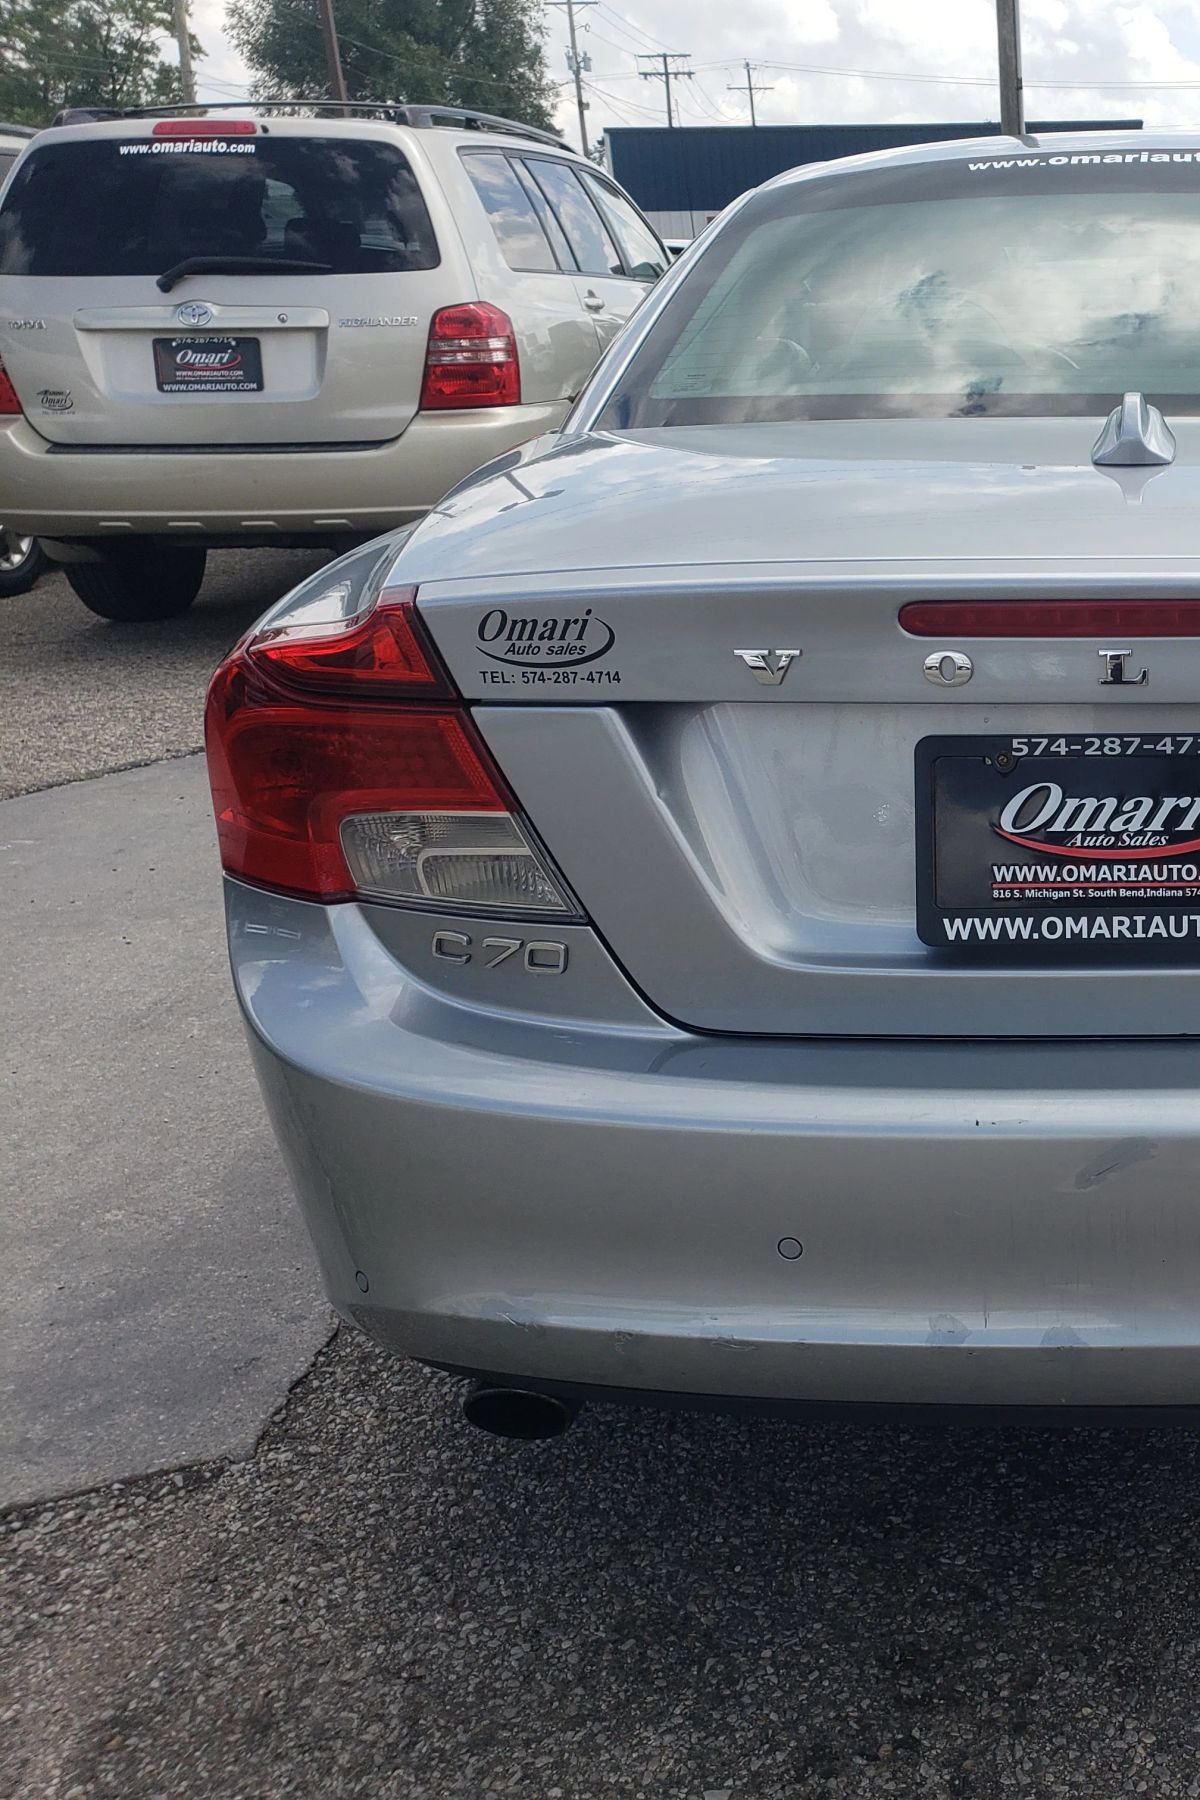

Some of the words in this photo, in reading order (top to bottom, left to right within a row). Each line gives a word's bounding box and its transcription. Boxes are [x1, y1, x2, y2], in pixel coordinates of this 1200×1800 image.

[119, 139, 256, 155] www.omariauto.com
[175, 349, 232, 364] Omari
[163, 383, 258, 391] WWW.OMARIAUTO.COM
[478, 608, 592, 641] Omari
[504, 642, 540, 656] Auto
[545, 642, 587, 656] sales
[479, 671, 516, 684] TEL:
[521, 671, 621, 684] 574-287-4714
[1067, 832, 1115, 847] Auto
[1118, 832, 1169, 847] Sales
[992, 888, 1012, 898] 816
[1013, 888, 1023, 898] S.
[1025, 887, 1070, 900] Michigan
[1072, 888, 1086, 897] St.
[1088, 887, 1117, 897] South
[431, 929, 569, 974] C70
